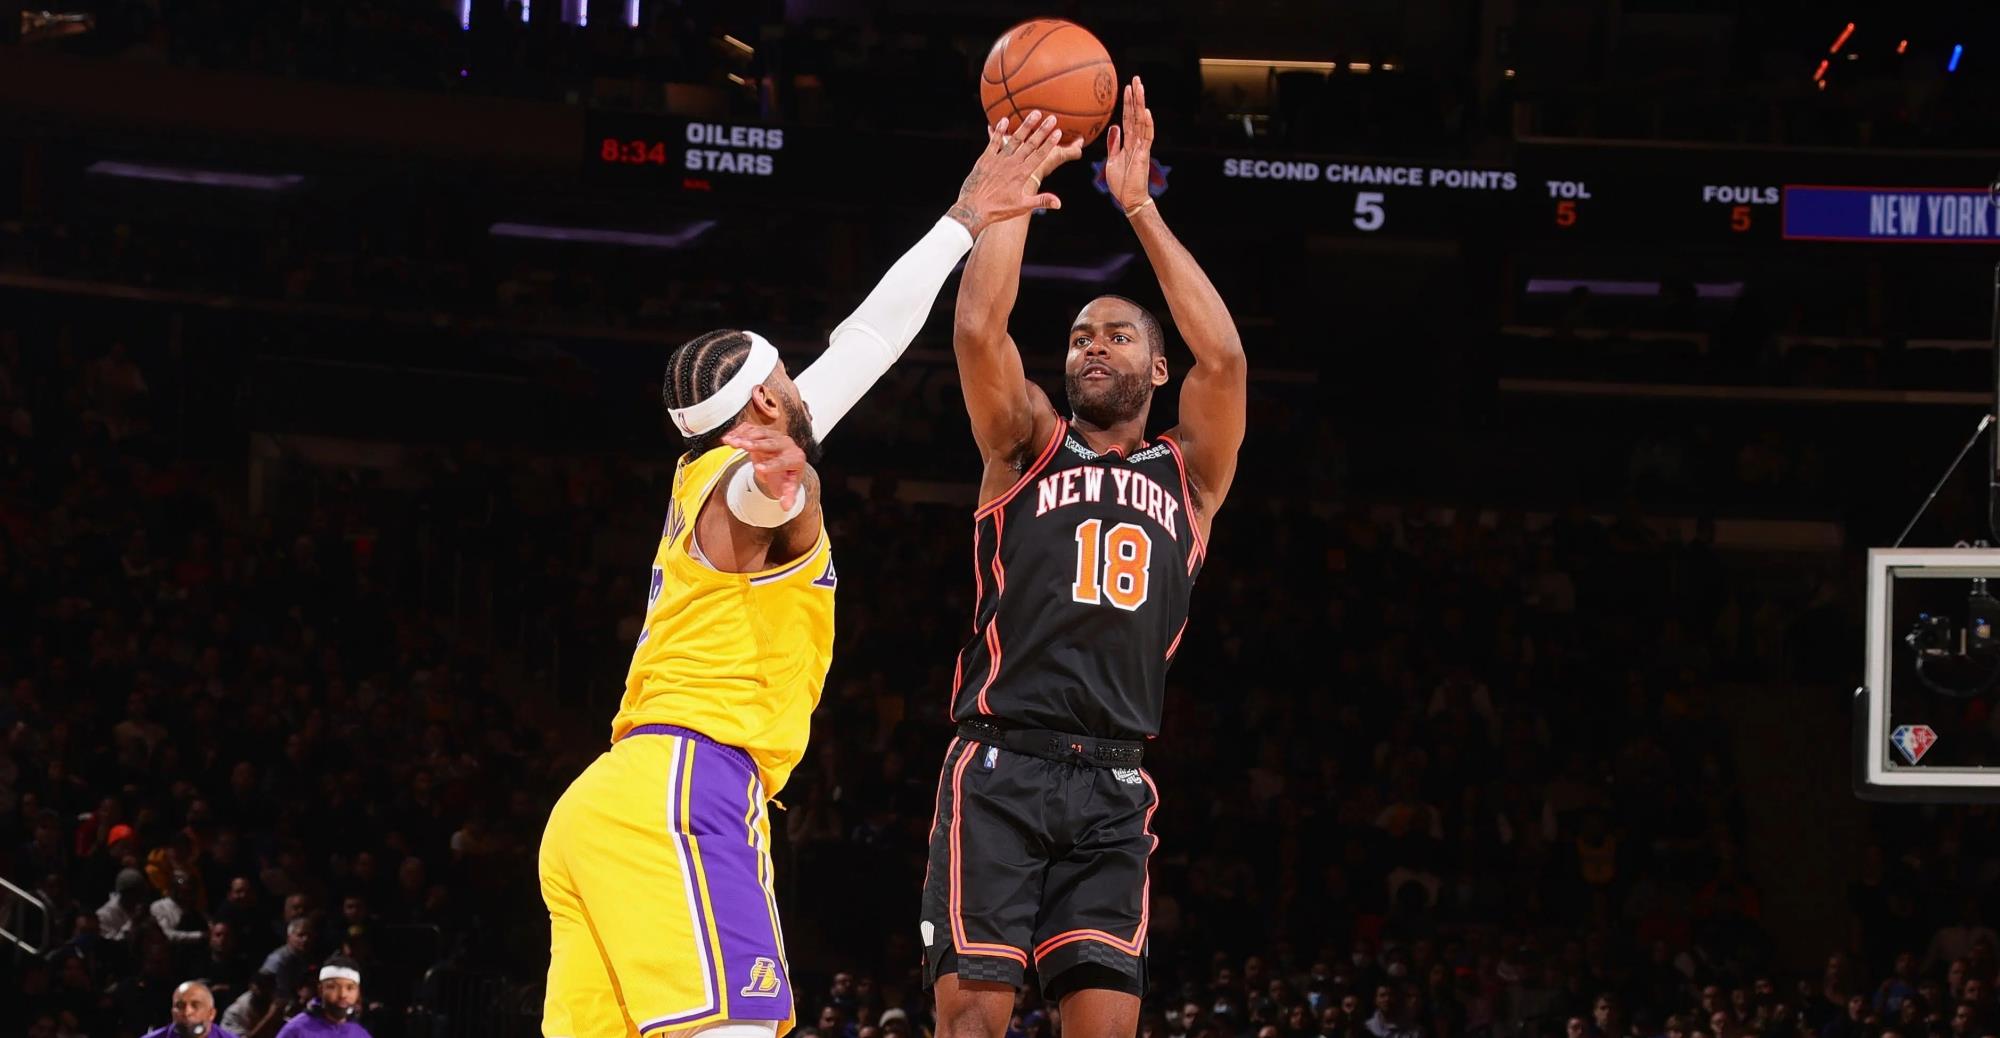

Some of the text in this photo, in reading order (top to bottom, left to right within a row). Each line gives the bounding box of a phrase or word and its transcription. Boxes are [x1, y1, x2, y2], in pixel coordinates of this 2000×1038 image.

[686, 122, 784, 149] OILERS
[601, 138, 666, 165] 8:34
[685, 149, 773, 175] STARS
[1224, 158, 1518, 190] SECOND CHANCE POINTS
[1547, 180, 1592, 199] TOL
[1703, 185, 1780, 204] FOULS
[1353, 192, 1386, 231] 5
[1556, 200, 1577, 227] 5
[1731, 205, 1752, 232] 5
[1869, 194, 1921, 236] NEW
[1926, 195, 1989, 236] YORK
[1035, 466, 1180, 542] NEW YORK
[1072, 517, 1152, 612] 18
